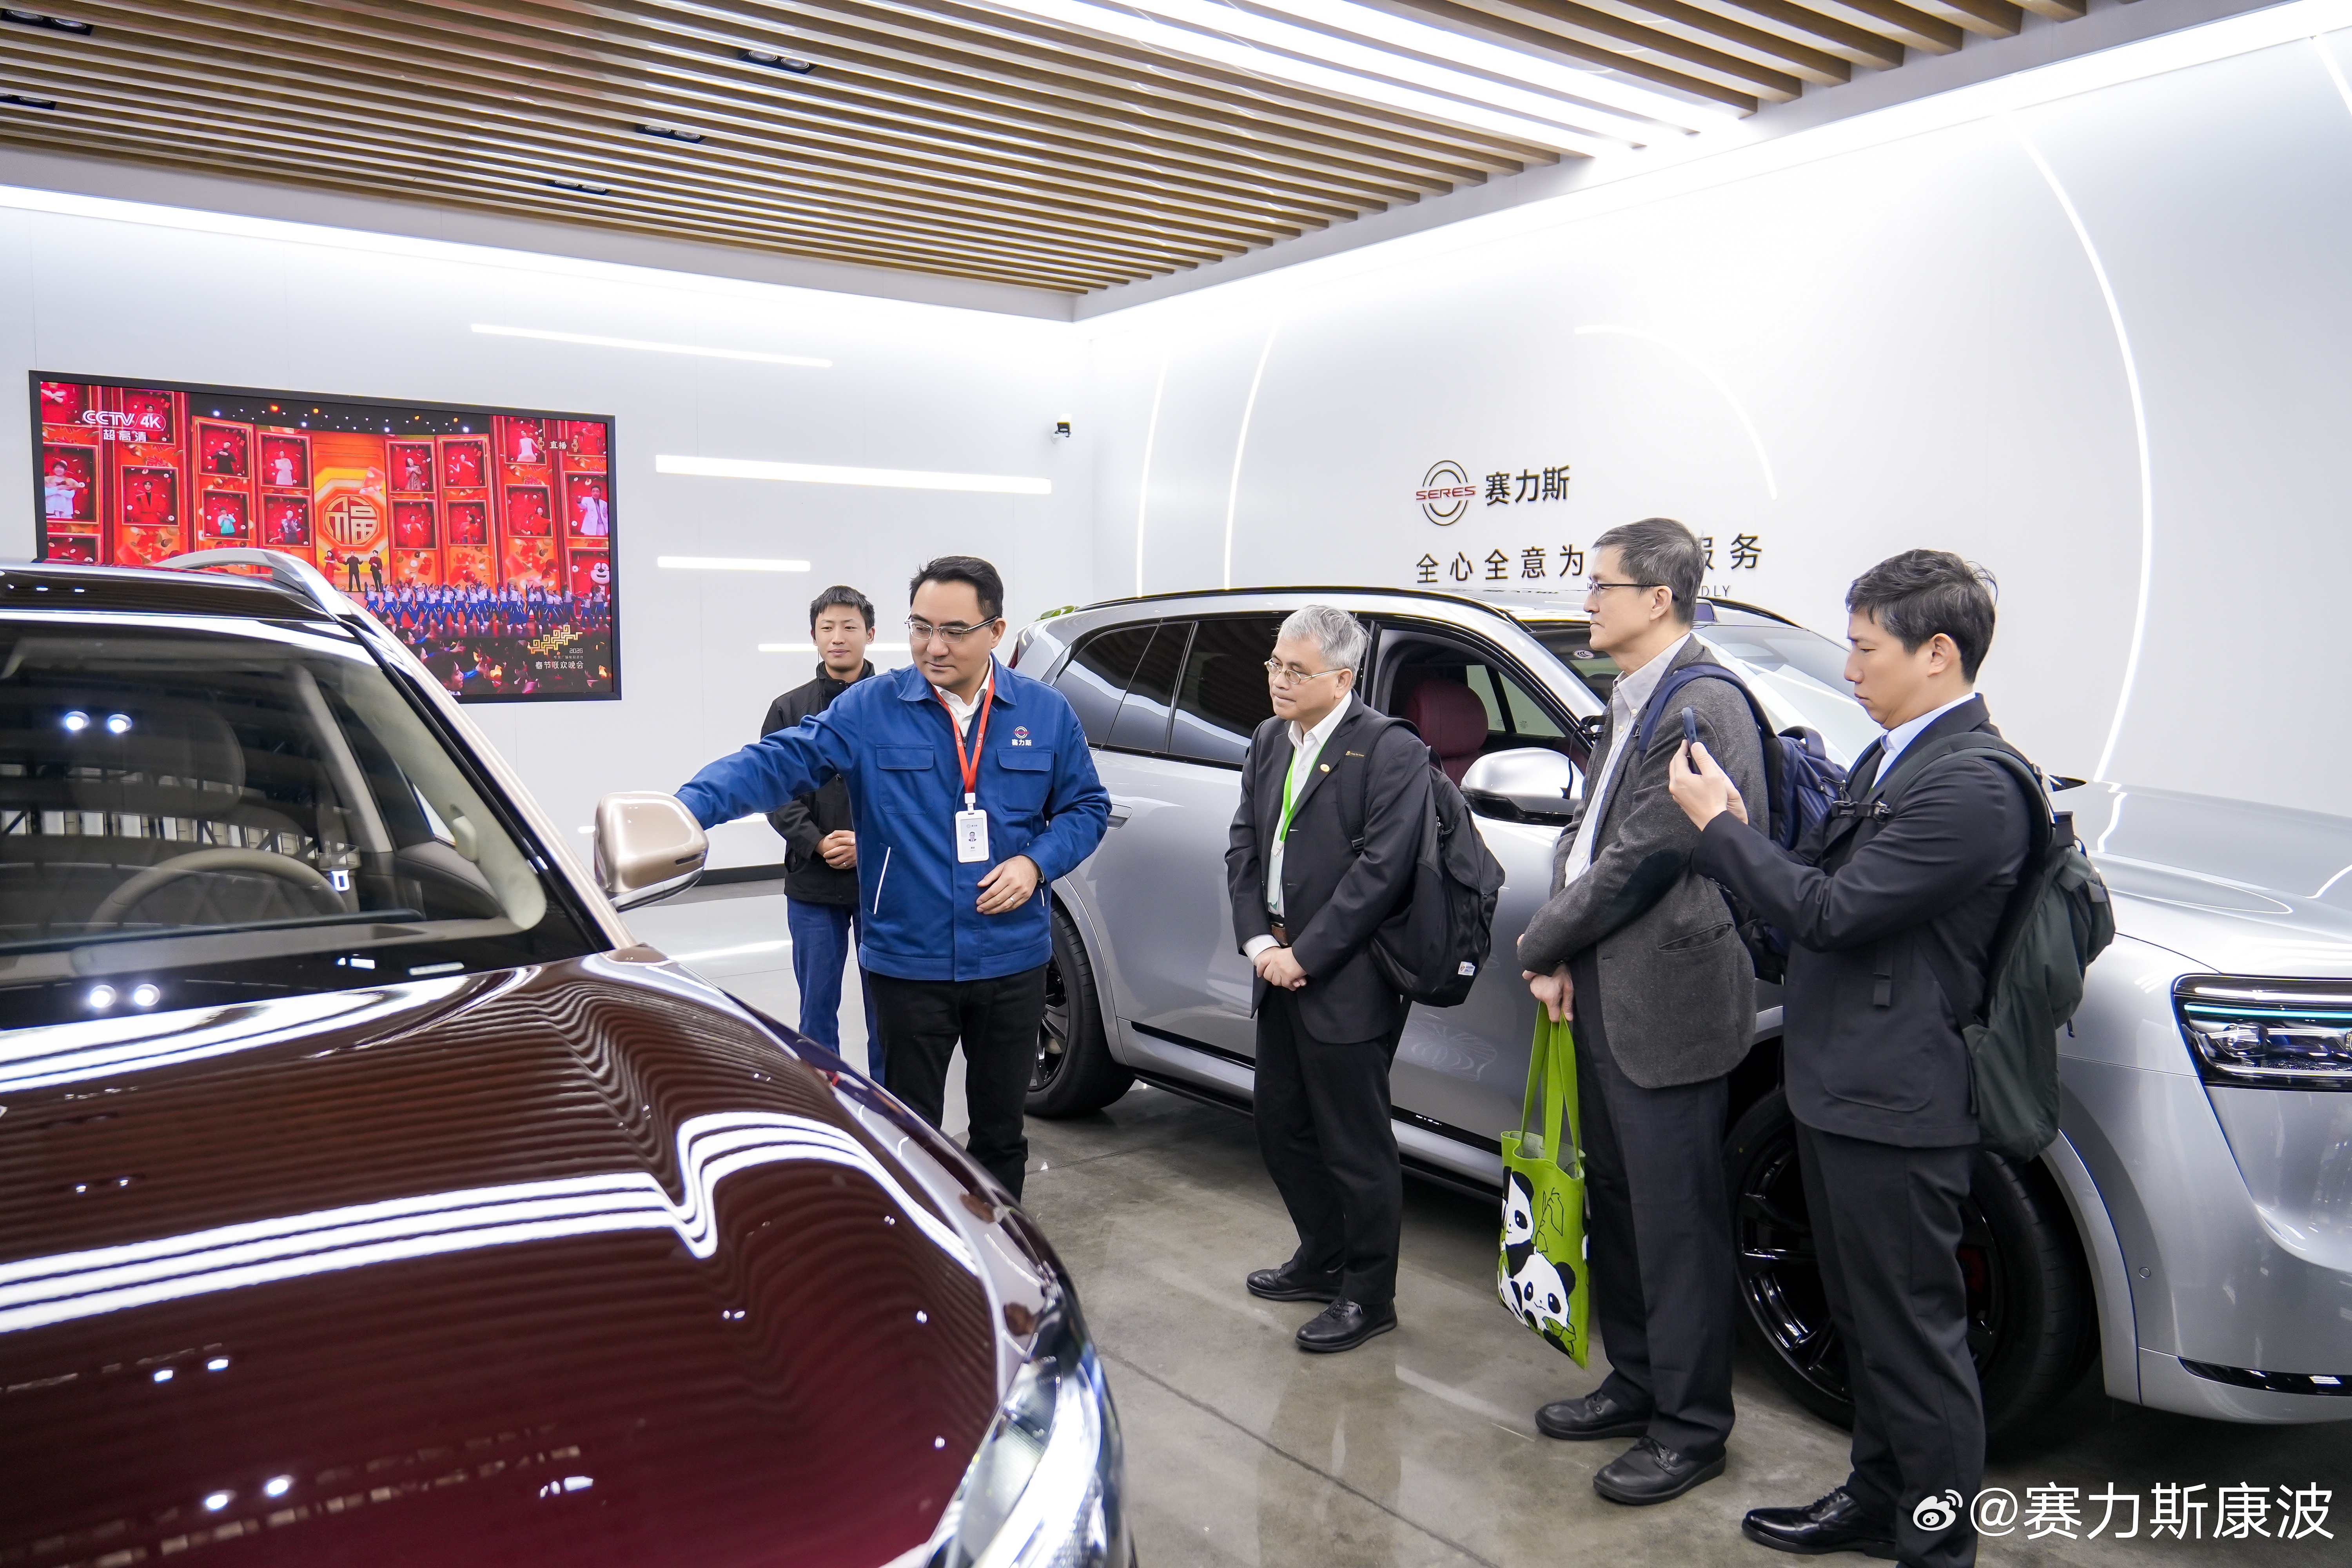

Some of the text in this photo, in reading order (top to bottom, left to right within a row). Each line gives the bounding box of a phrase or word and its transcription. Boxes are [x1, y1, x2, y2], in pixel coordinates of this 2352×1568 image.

[83, 410, 161, 428] CCTV 4K
[103, 429, 146, 442] 超高清
[549, 441, 567, 449] 直播
[1416, 485, 1477, 500] SERES
[1485, 465, 1570, 506] 赛力斯
[325, 496, 377, 544] 福
[1416, 544, 1584, 583] 全心全意为
[535, 661, 584, 669] 春节联欢晚会
